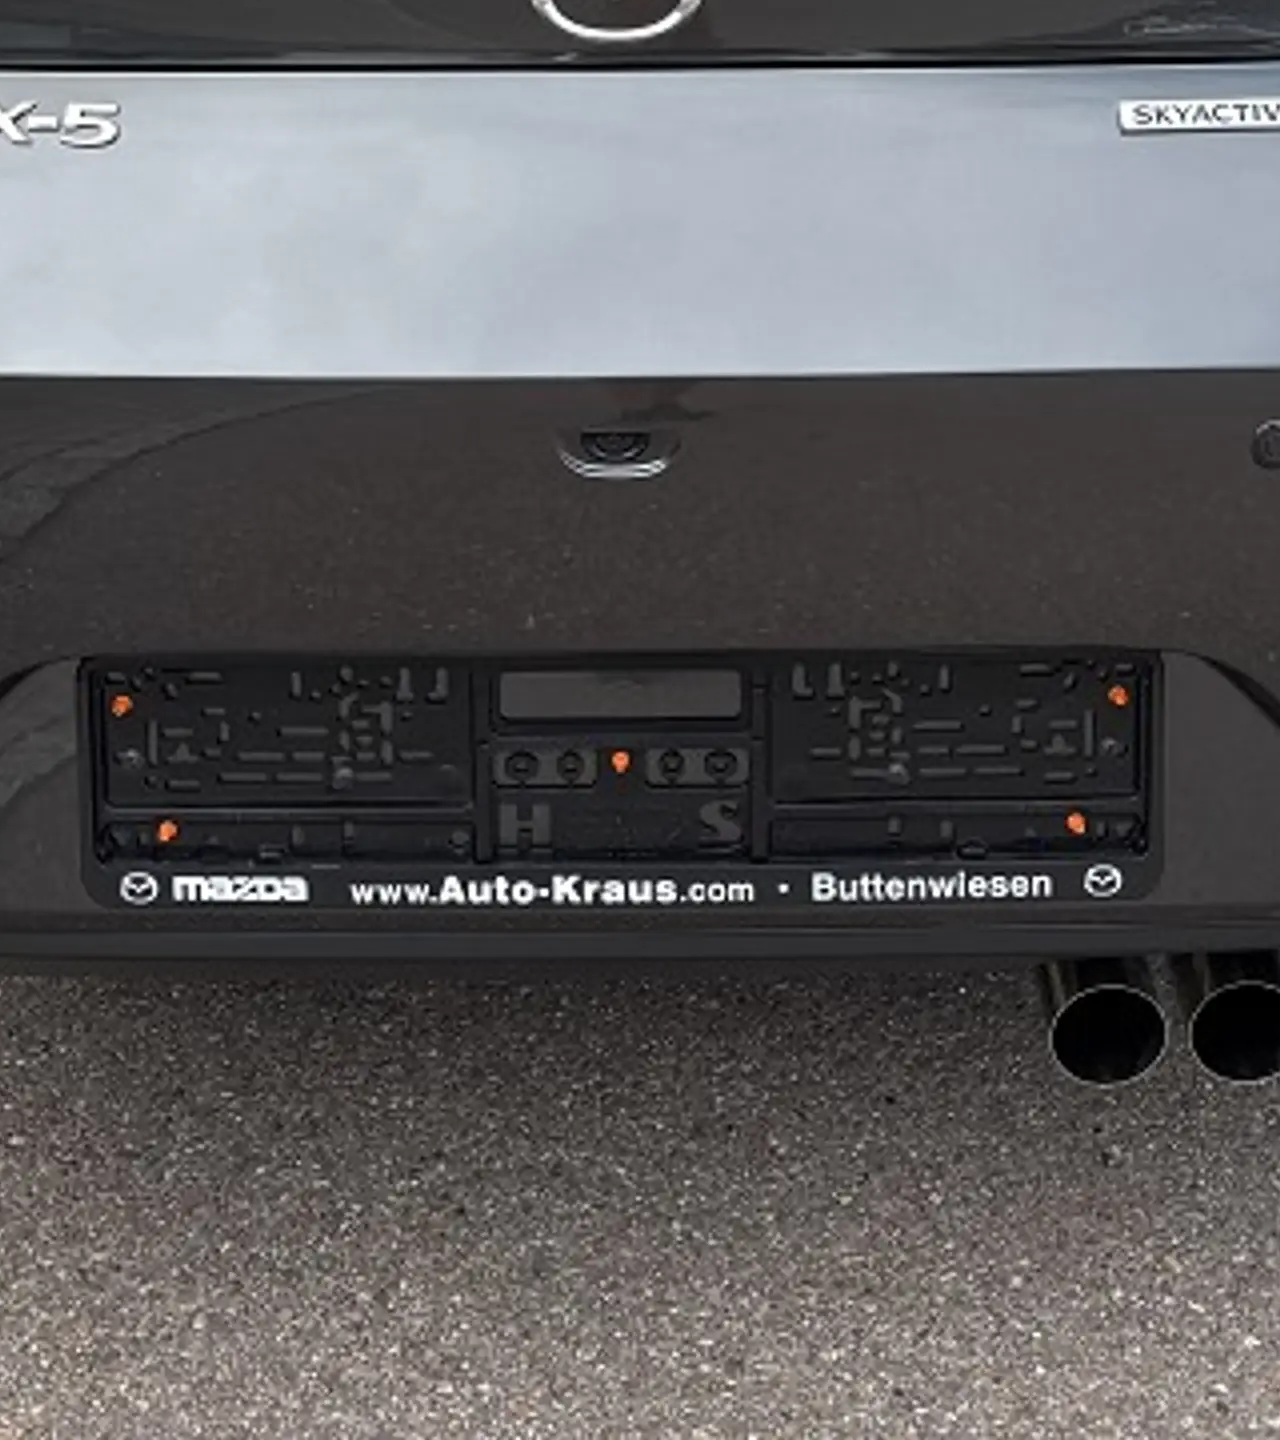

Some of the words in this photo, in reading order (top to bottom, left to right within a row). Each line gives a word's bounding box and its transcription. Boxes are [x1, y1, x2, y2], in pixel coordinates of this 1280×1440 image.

[172, 875, 309, 902] mazda
[349, 874, 755, 905] www.Auto-Kraus.com
[811, 870, 1054, 902] Buttenwiesen
